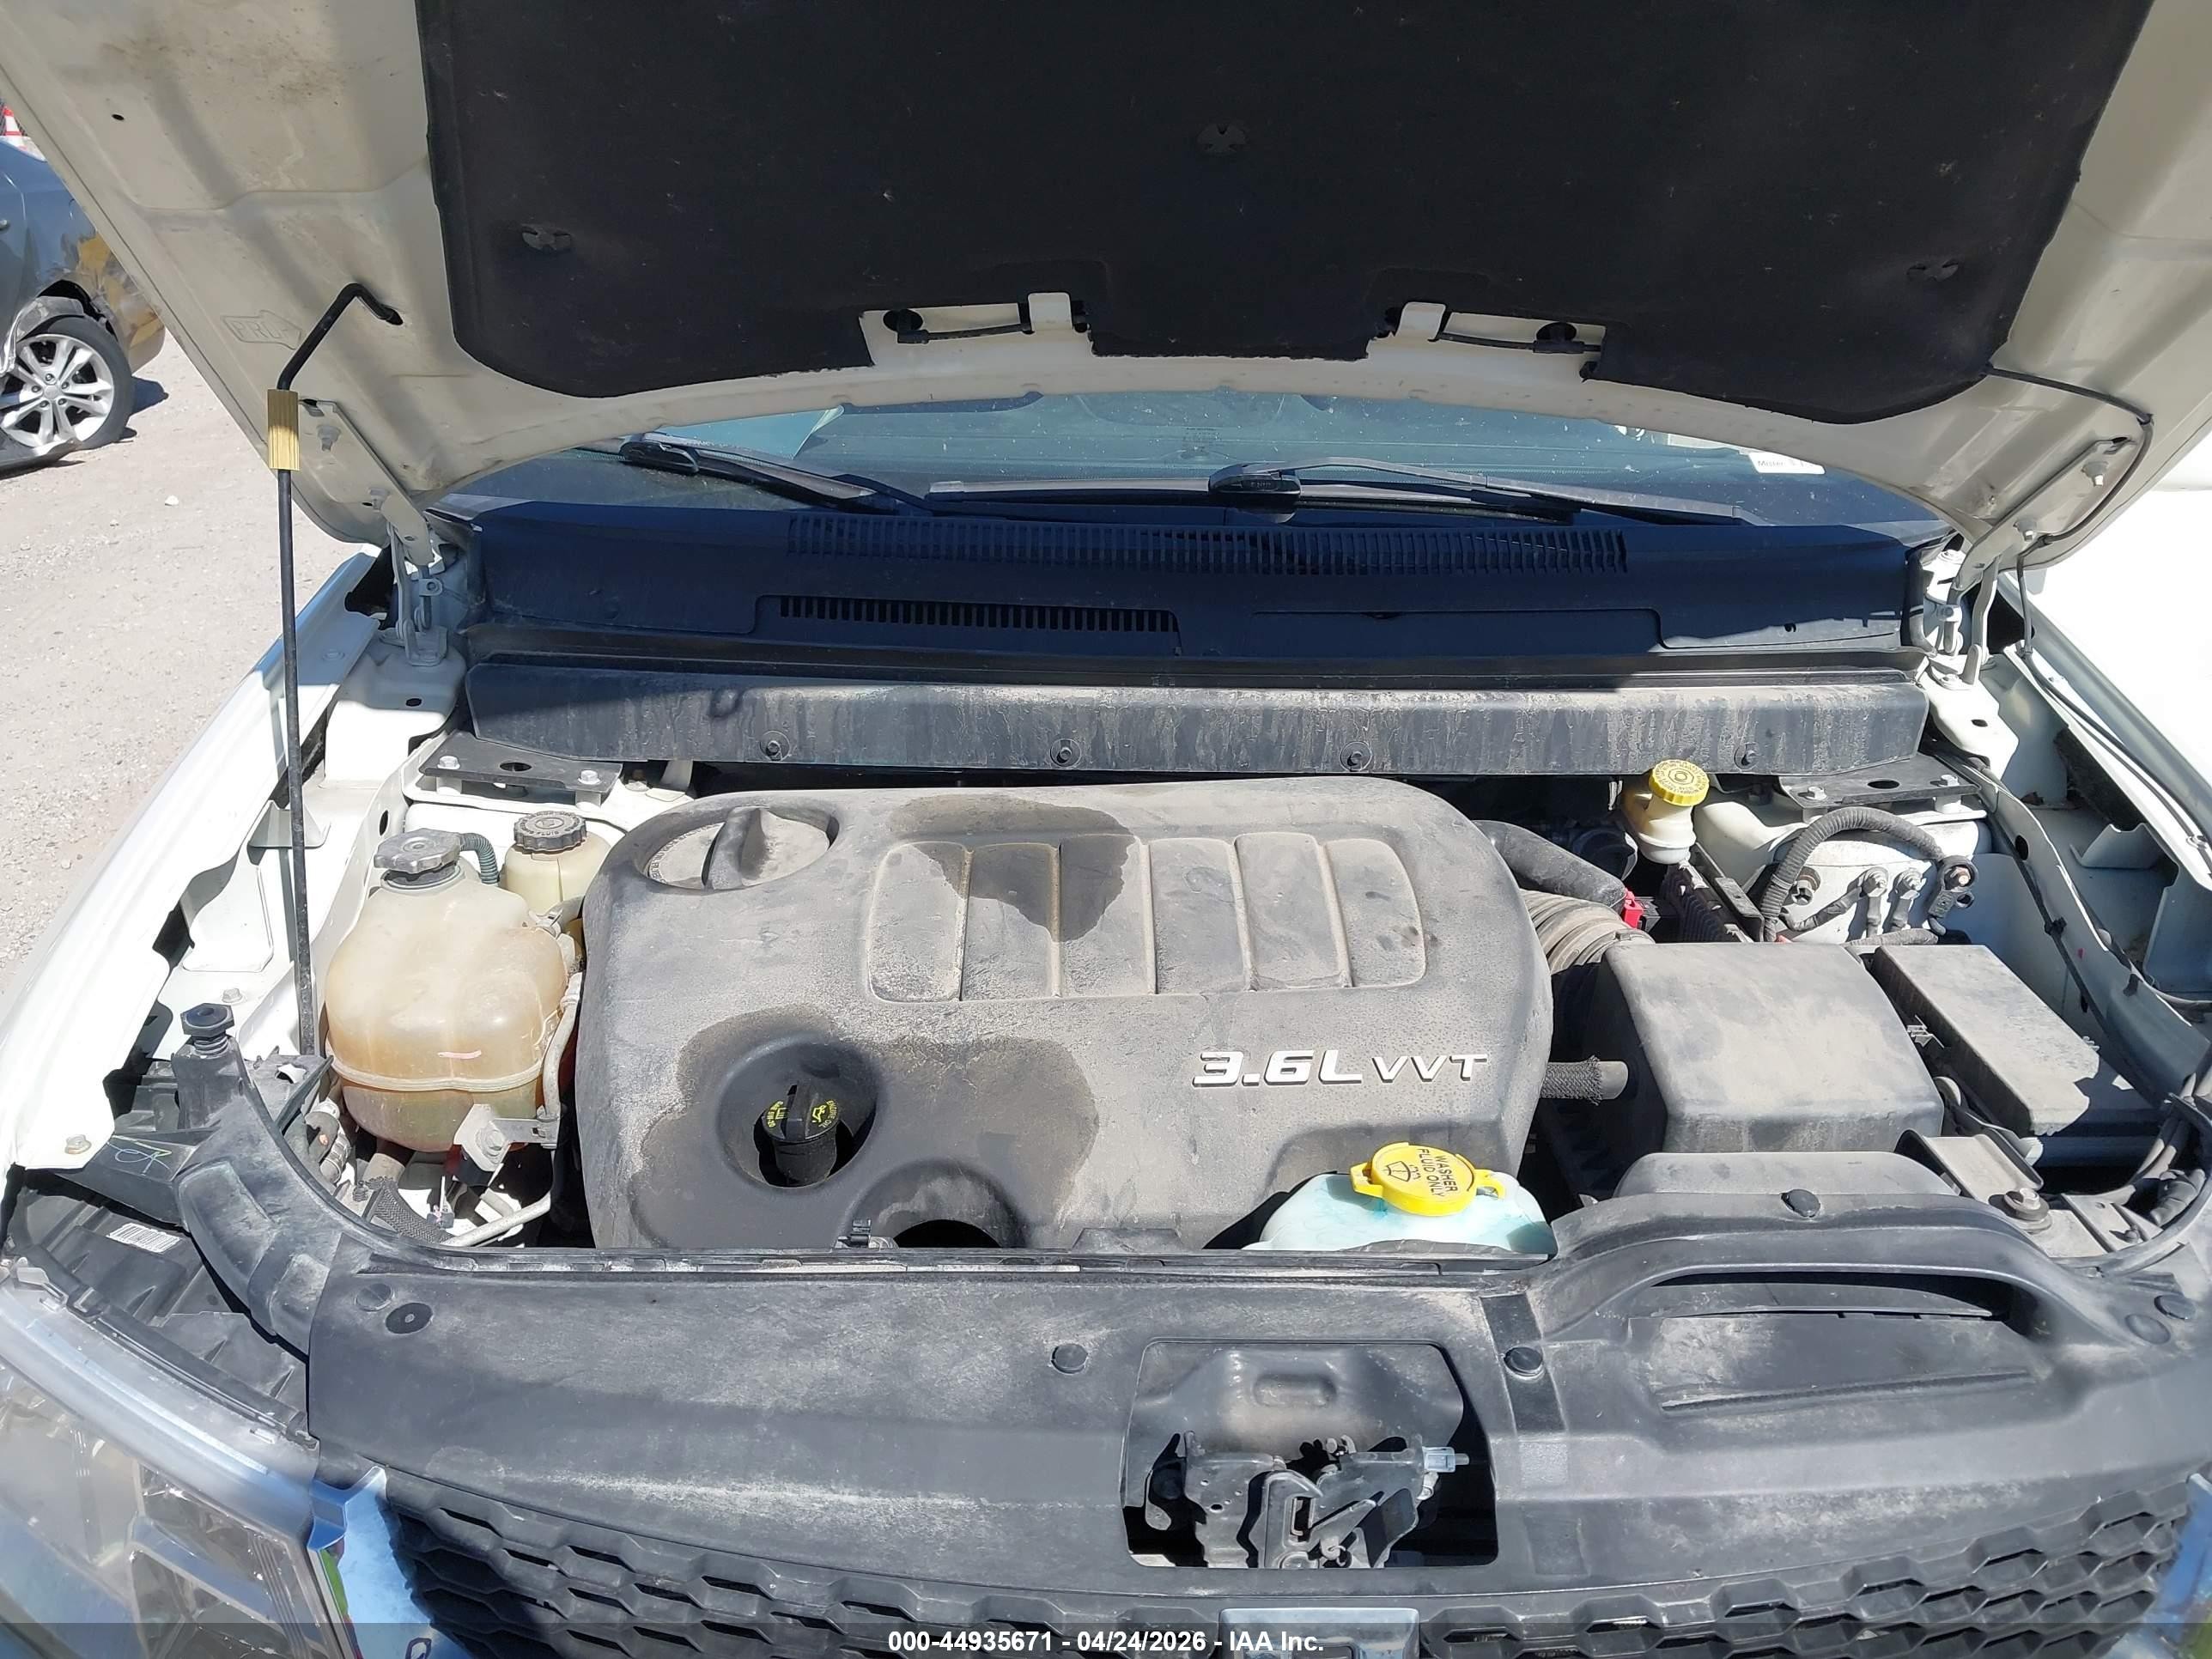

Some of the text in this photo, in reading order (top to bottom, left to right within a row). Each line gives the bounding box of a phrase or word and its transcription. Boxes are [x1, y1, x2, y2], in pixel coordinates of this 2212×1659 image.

[1192, 1049, 1488, 1087] 3.6L VVT
[818, 1119, 832, 1127] OIL
[1418, 1148, 1445, 1198] FLUID ONLY
[1435, 1155, 1459, 1193] WASHER
